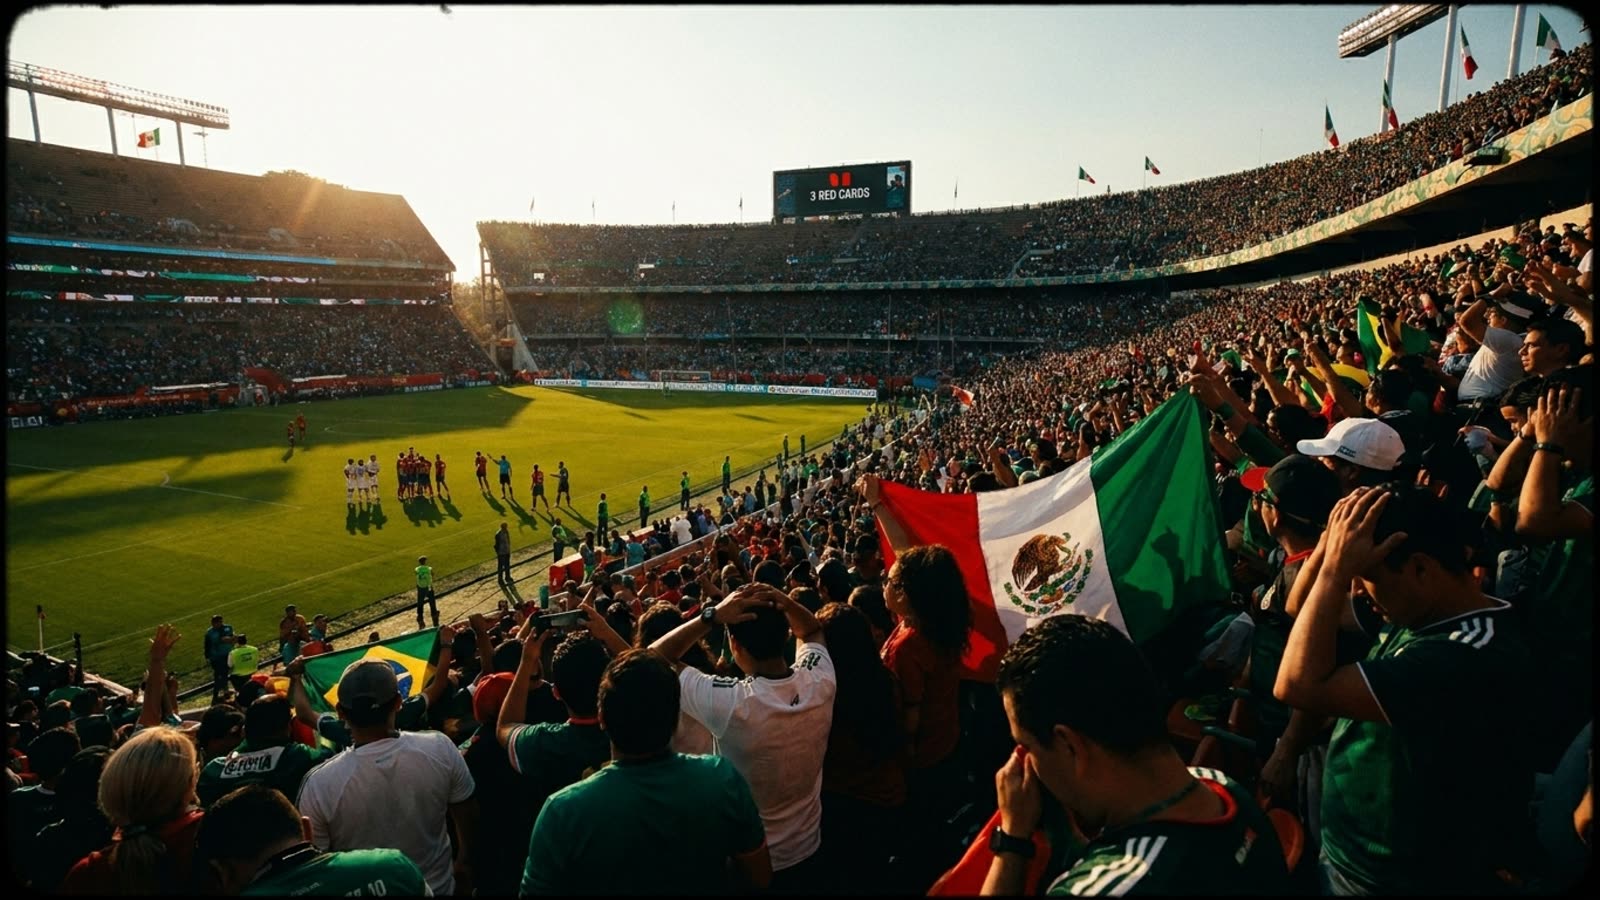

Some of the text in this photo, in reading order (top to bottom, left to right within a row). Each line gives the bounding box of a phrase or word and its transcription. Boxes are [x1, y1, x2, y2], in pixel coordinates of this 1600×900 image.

[810, 187, 870, 201] 3 RED CARDS
[367, 879, 387, 897] 10
